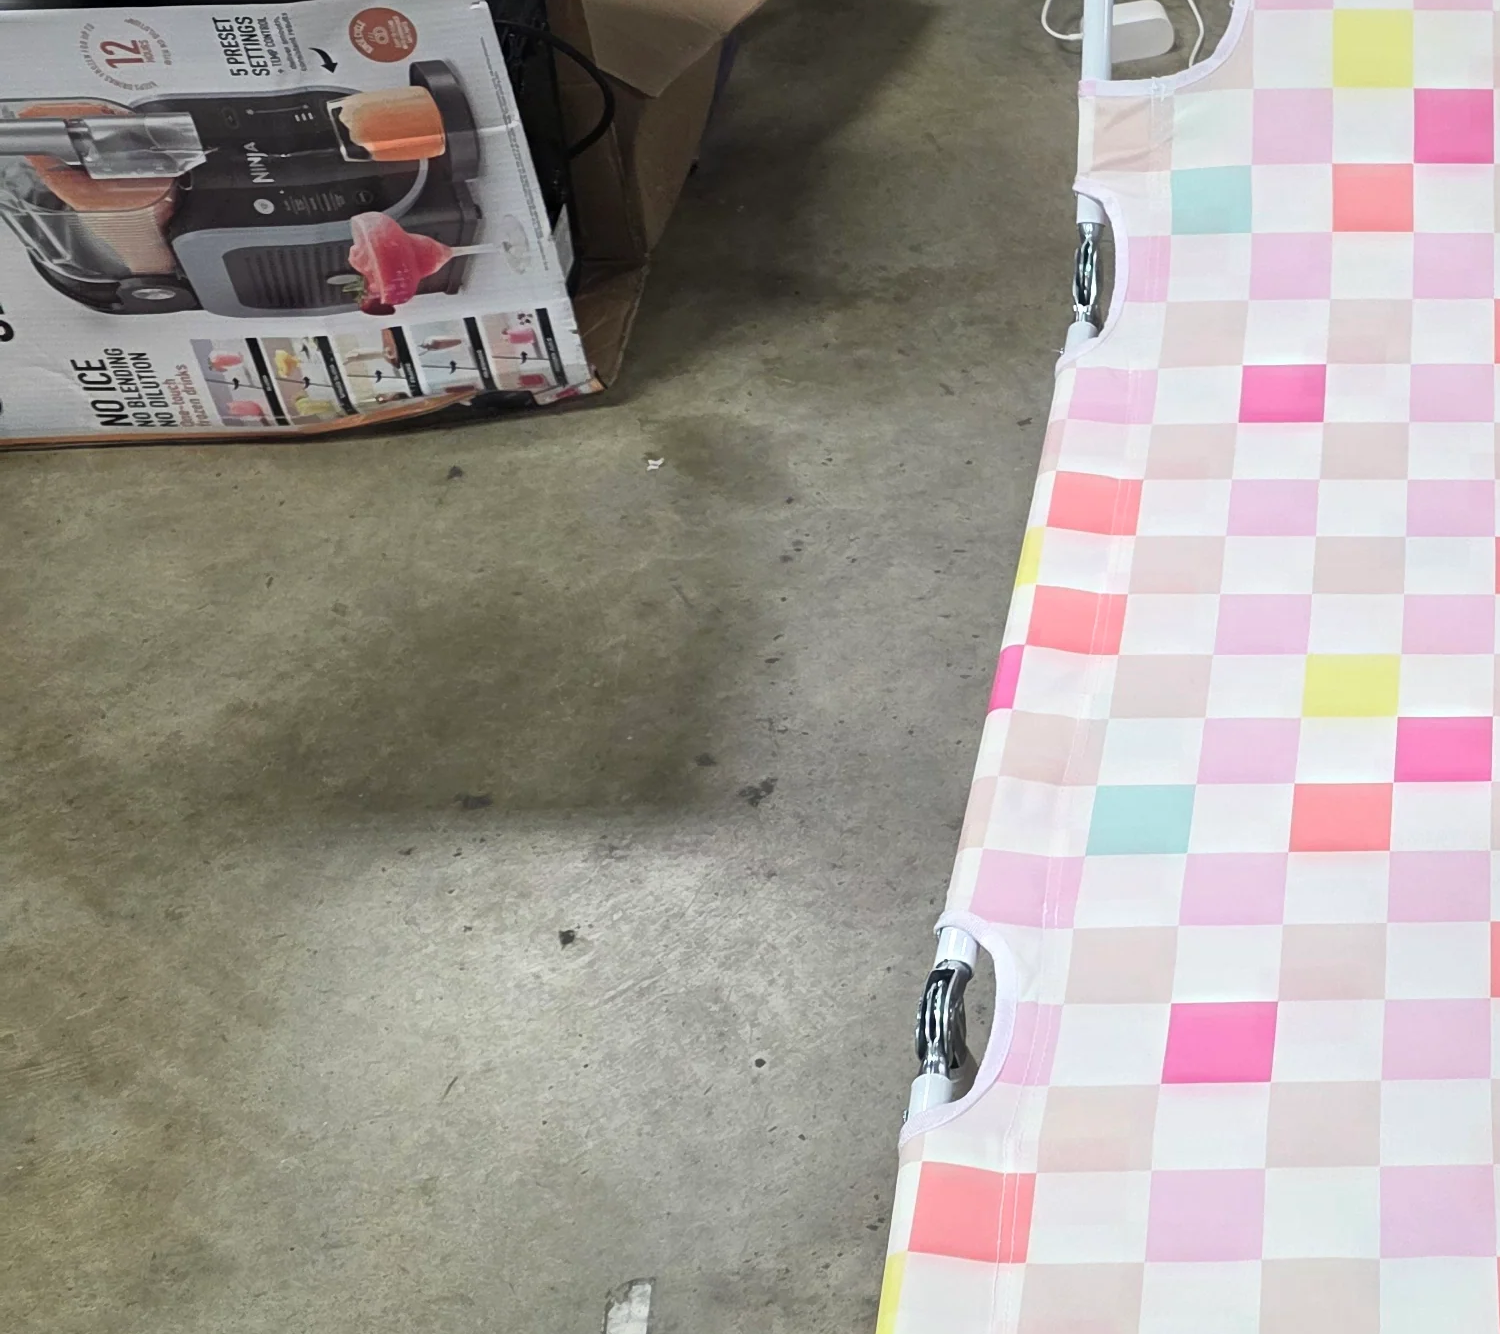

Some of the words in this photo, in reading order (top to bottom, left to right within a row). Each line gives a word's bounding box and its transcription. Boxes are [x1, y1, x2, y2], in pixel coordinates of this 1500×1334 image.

[212, 17, 244, 66] PRESET
[235, 16, 270, 76] SETTINGS
[259, 16, 276, 48] CONTROL
[100, 40, 141, 68] 12
[139, 40, 155, 65] HOURS
[269, 48, 282, 66] TEMP
[229, 68, 248, 77] 5
[244, 142, 275, 183] NINJA
[70, 359, 116, 391] ICE
[104, 348, 146, 408] BLENDING
[128, 352, 169, 408] DILUTION
[176, 364, 196, 395] drinks
[91, 399, 133, 427] NO
[165, 379, 194, 427] One-touch
[132, 412, 155, 427] NO
[155, 412, 179, 427] NO
